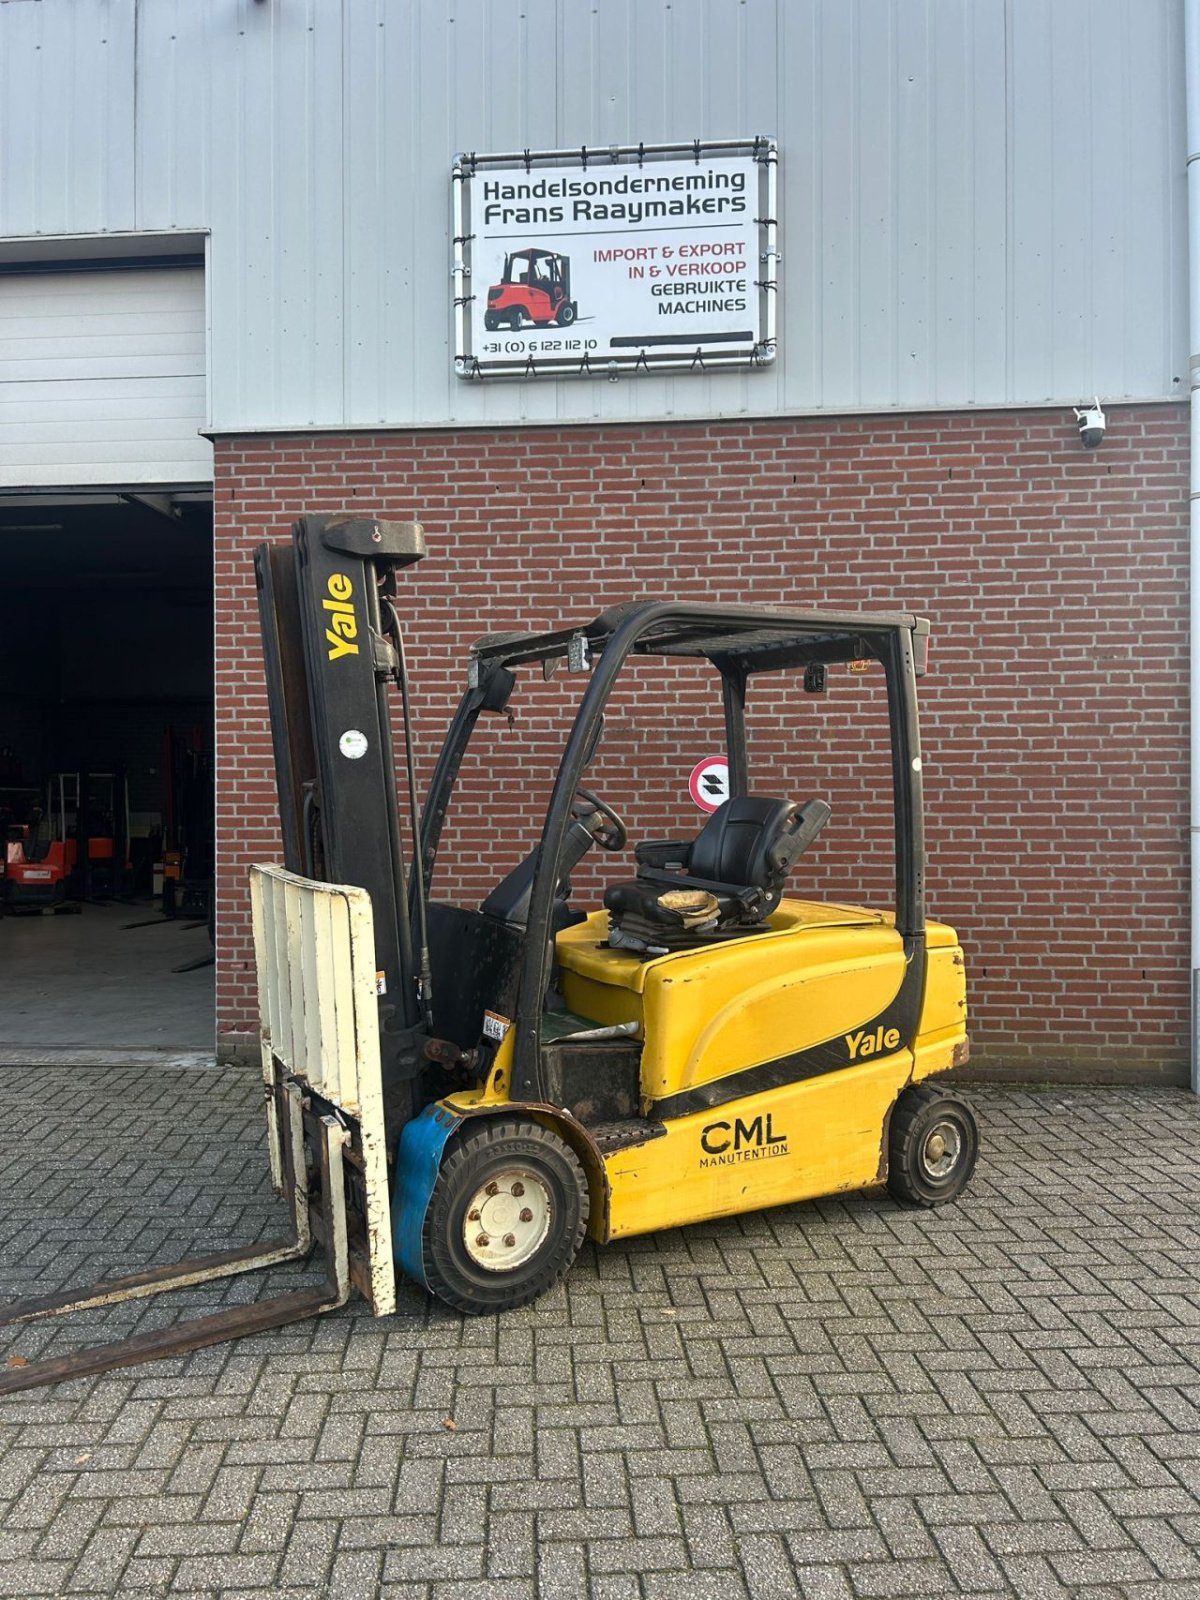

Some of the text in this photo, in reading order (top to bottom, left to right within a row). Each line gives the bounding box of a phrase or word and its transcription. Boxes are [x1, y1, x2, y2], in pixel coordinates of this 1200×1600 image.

[483, 170, 745, 200] Handelsonderneming
[484, 194, 746, 225] Frans Raaymakers
[593, 242, 746, 263] IMPORT & EXPORT
[628, 261, 746, 279] IN & VERKOOP
[651, 279, 746, 297] GEBRUIKTE
[658, 298, 746, 315] MACHINES
[482, 339, 598, 353] +31 (0) 6 122 112 10
[322, 573, 359, 661] Yale
[845, 1025, 900, 1060] Yale
[700, 1113, 787, 1155] CML
[699, 1143, 789, 1168] MANUTENTION
